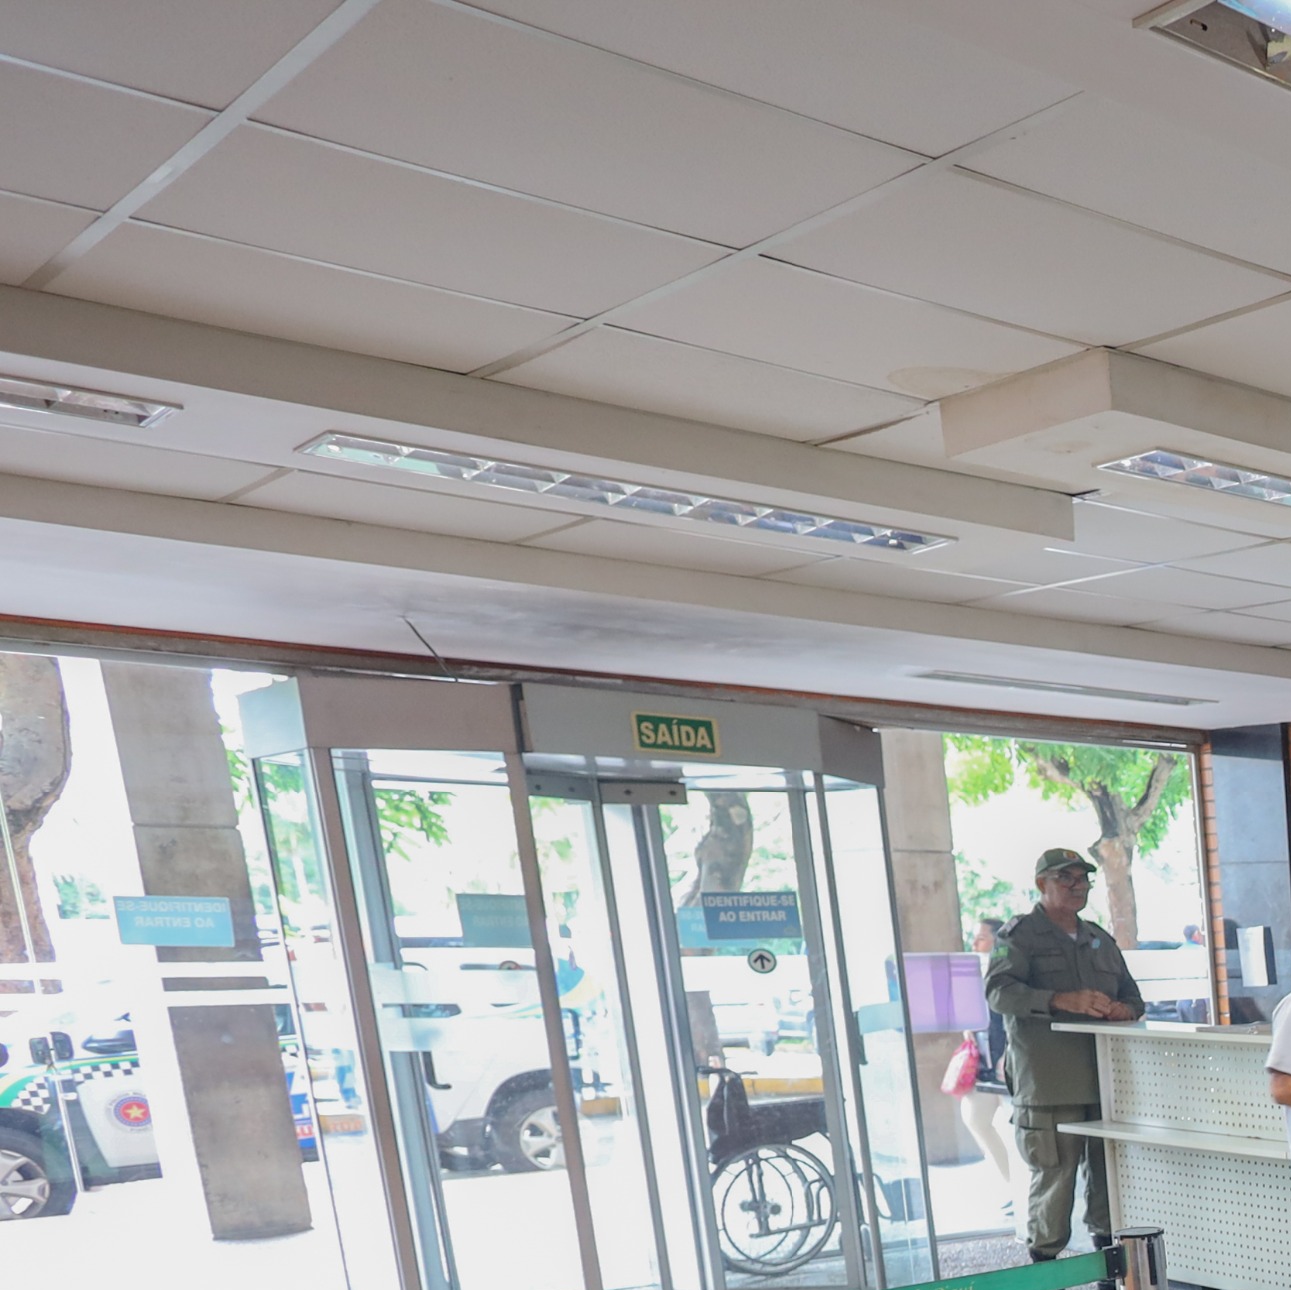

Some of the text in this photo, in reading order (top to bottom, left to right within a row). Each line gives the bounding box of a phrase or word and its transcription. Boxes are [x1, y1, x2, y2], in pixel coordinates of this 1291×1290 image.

[640, 719, 713, 749] SAÍDA
[703, 894, 795, 908] IDENTIFIQUE-SE
[718, 911, 737, 923] AO
[739, 910, 787, 922] ENTRAR
